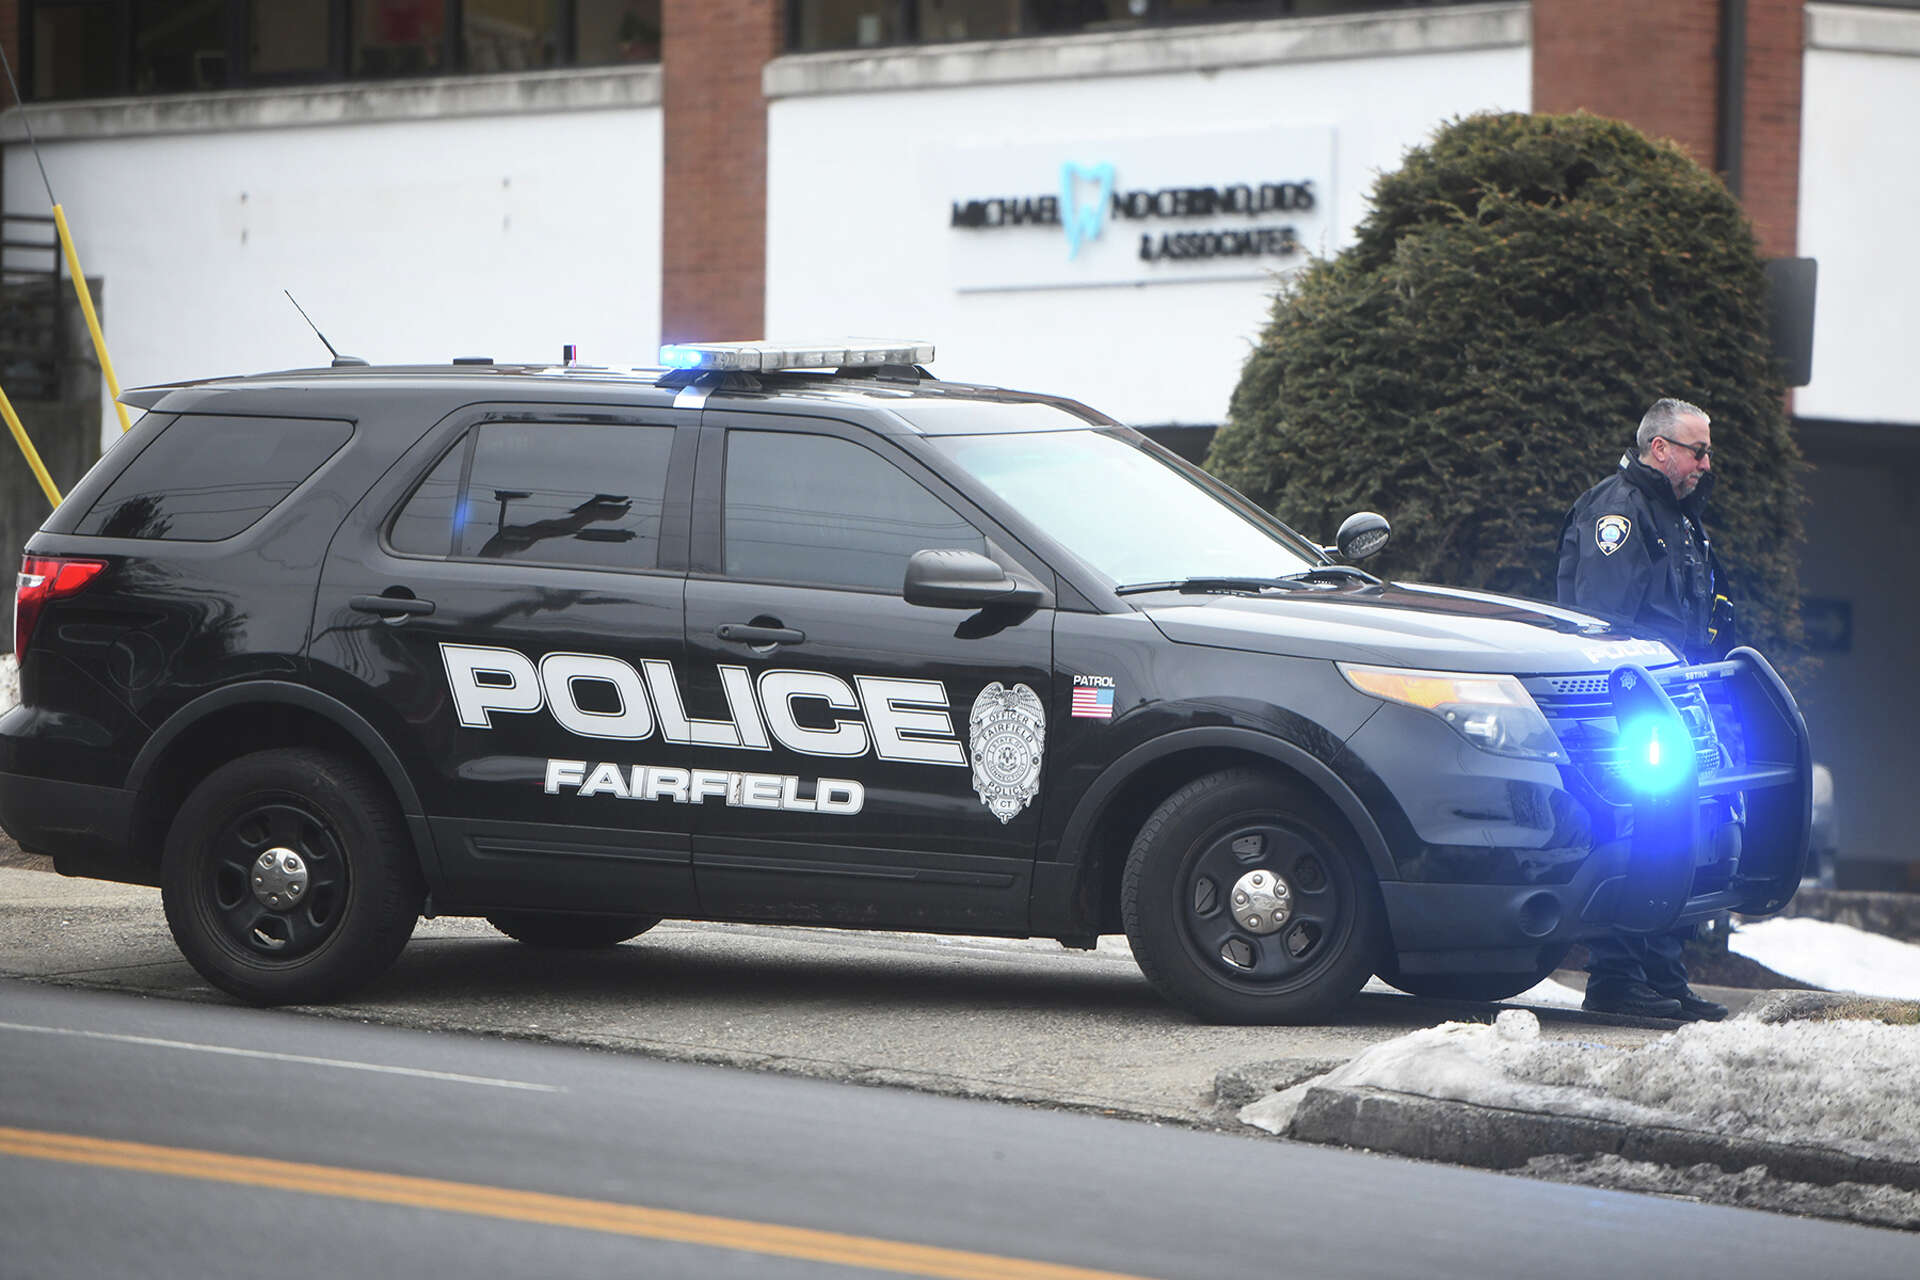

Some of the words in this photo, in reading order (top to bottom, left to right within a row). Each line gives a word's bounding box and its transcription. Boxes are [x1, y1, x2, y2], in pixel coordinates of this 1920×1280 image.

[1073, 675, 1115, 687] PATROL
[438, 642, 968, 767] POLICE
[989, 711, 1029, 724] OFFICER
[982, 723, 1033, 743] FAIRFIELD
[544, 758, 865, 816] FAIRFIELD
[988, 781, 1027, 797] POLICE
[1001, 800, 1012, 808] CT
